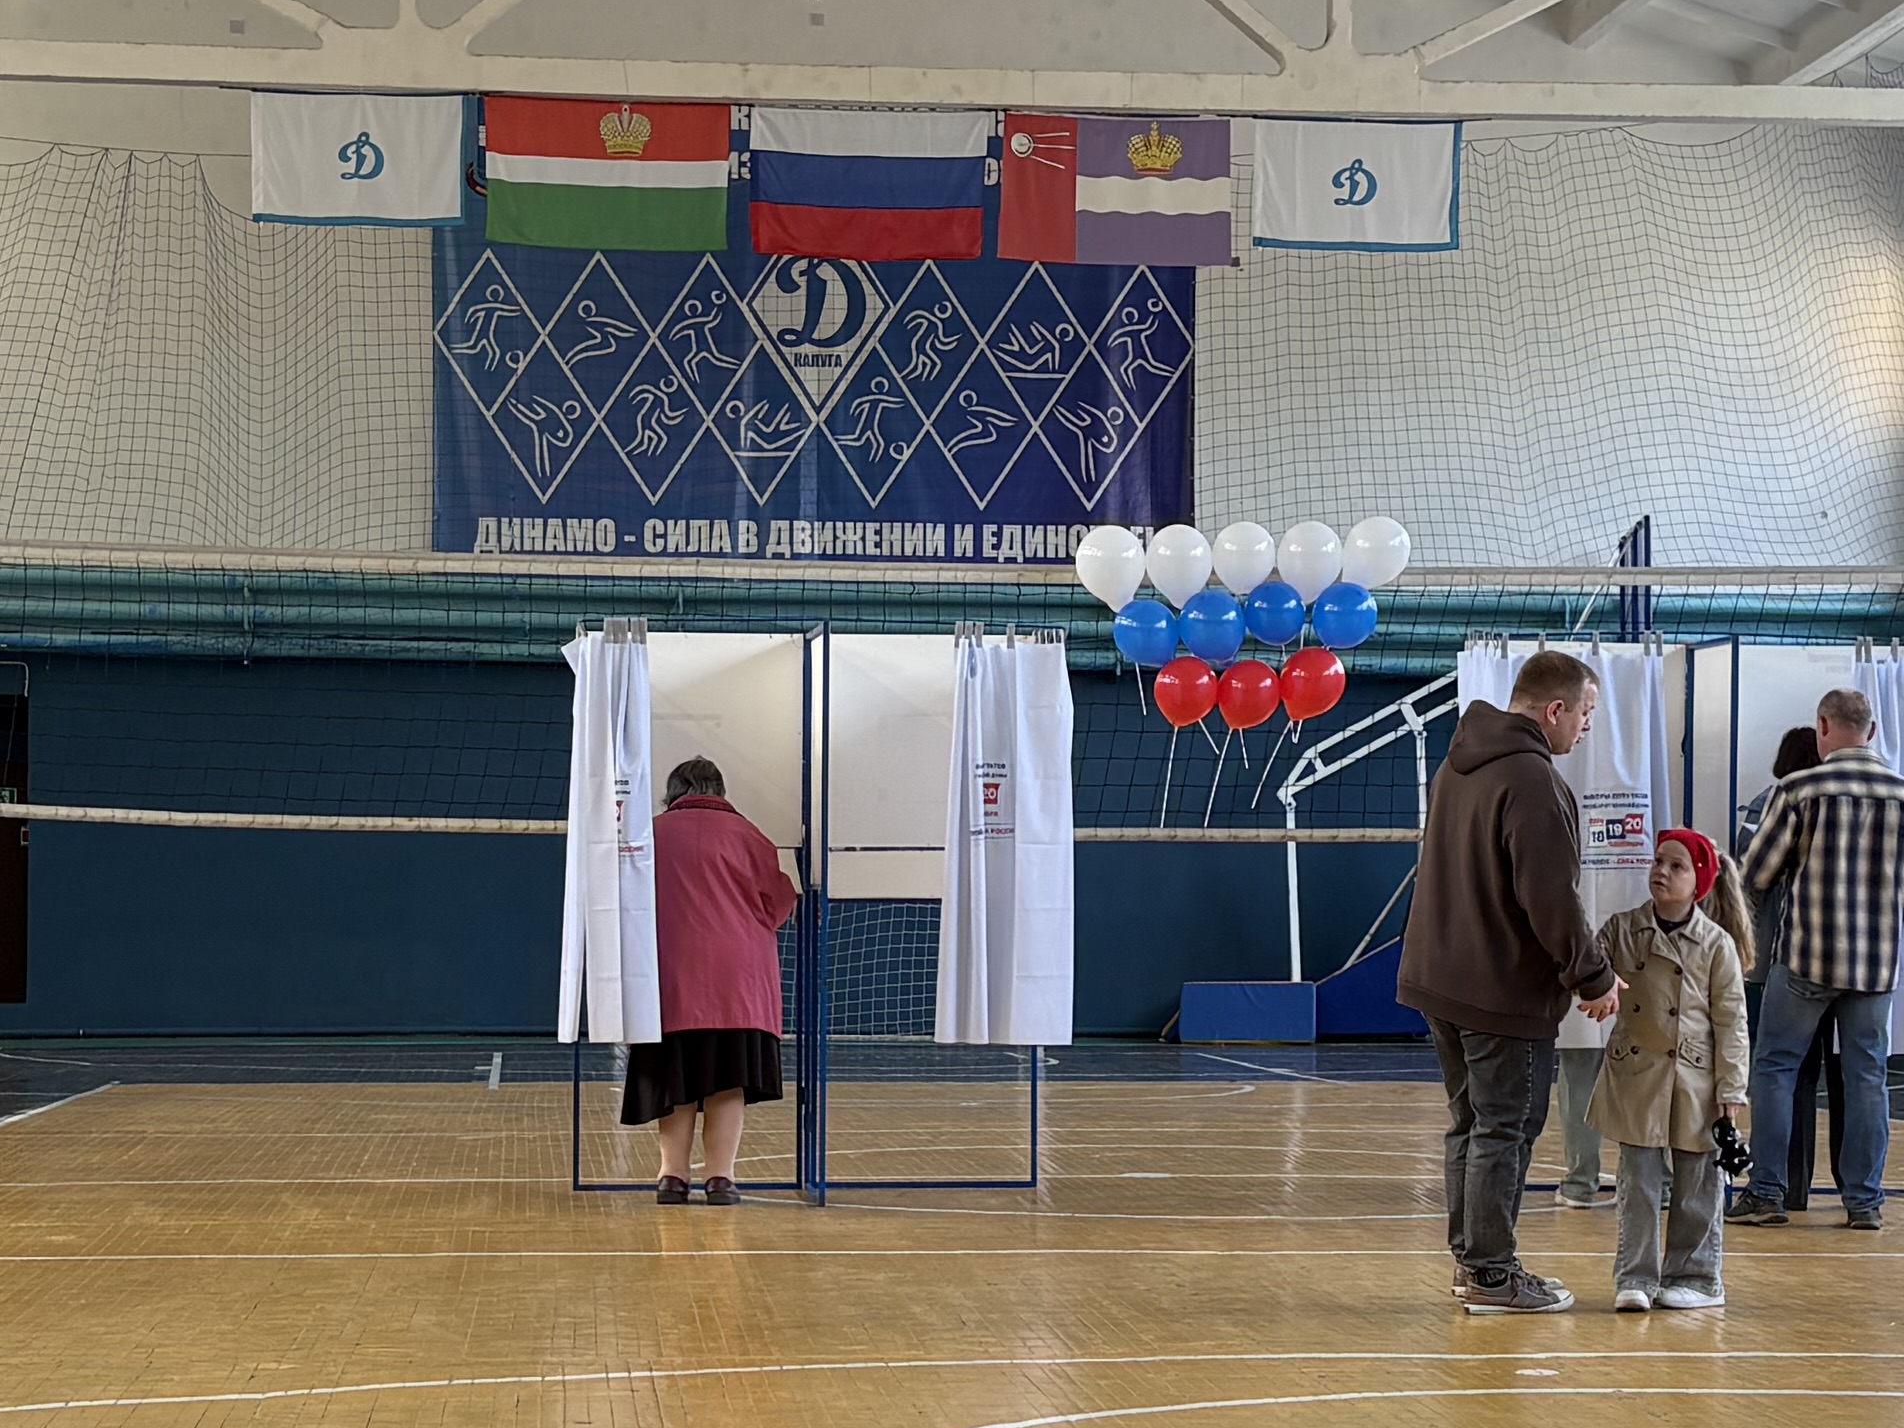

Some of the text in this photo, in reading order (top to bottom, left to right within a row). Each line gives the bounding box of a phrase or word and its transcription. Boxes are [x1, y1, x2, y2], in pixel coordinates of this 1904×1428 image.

[794, 353, 842, 368] КАЛУГА
[474, 517, 617, 554] ДИНАМО
[643, 519, 732, 553] СИЛА
[737, 519, 759, 554] В
[765, 519, 946, 559] ДВИЖЕНИИ
[953, 523, 974, 557] И
[1592, 817, 1642, 843] 18 19 20
